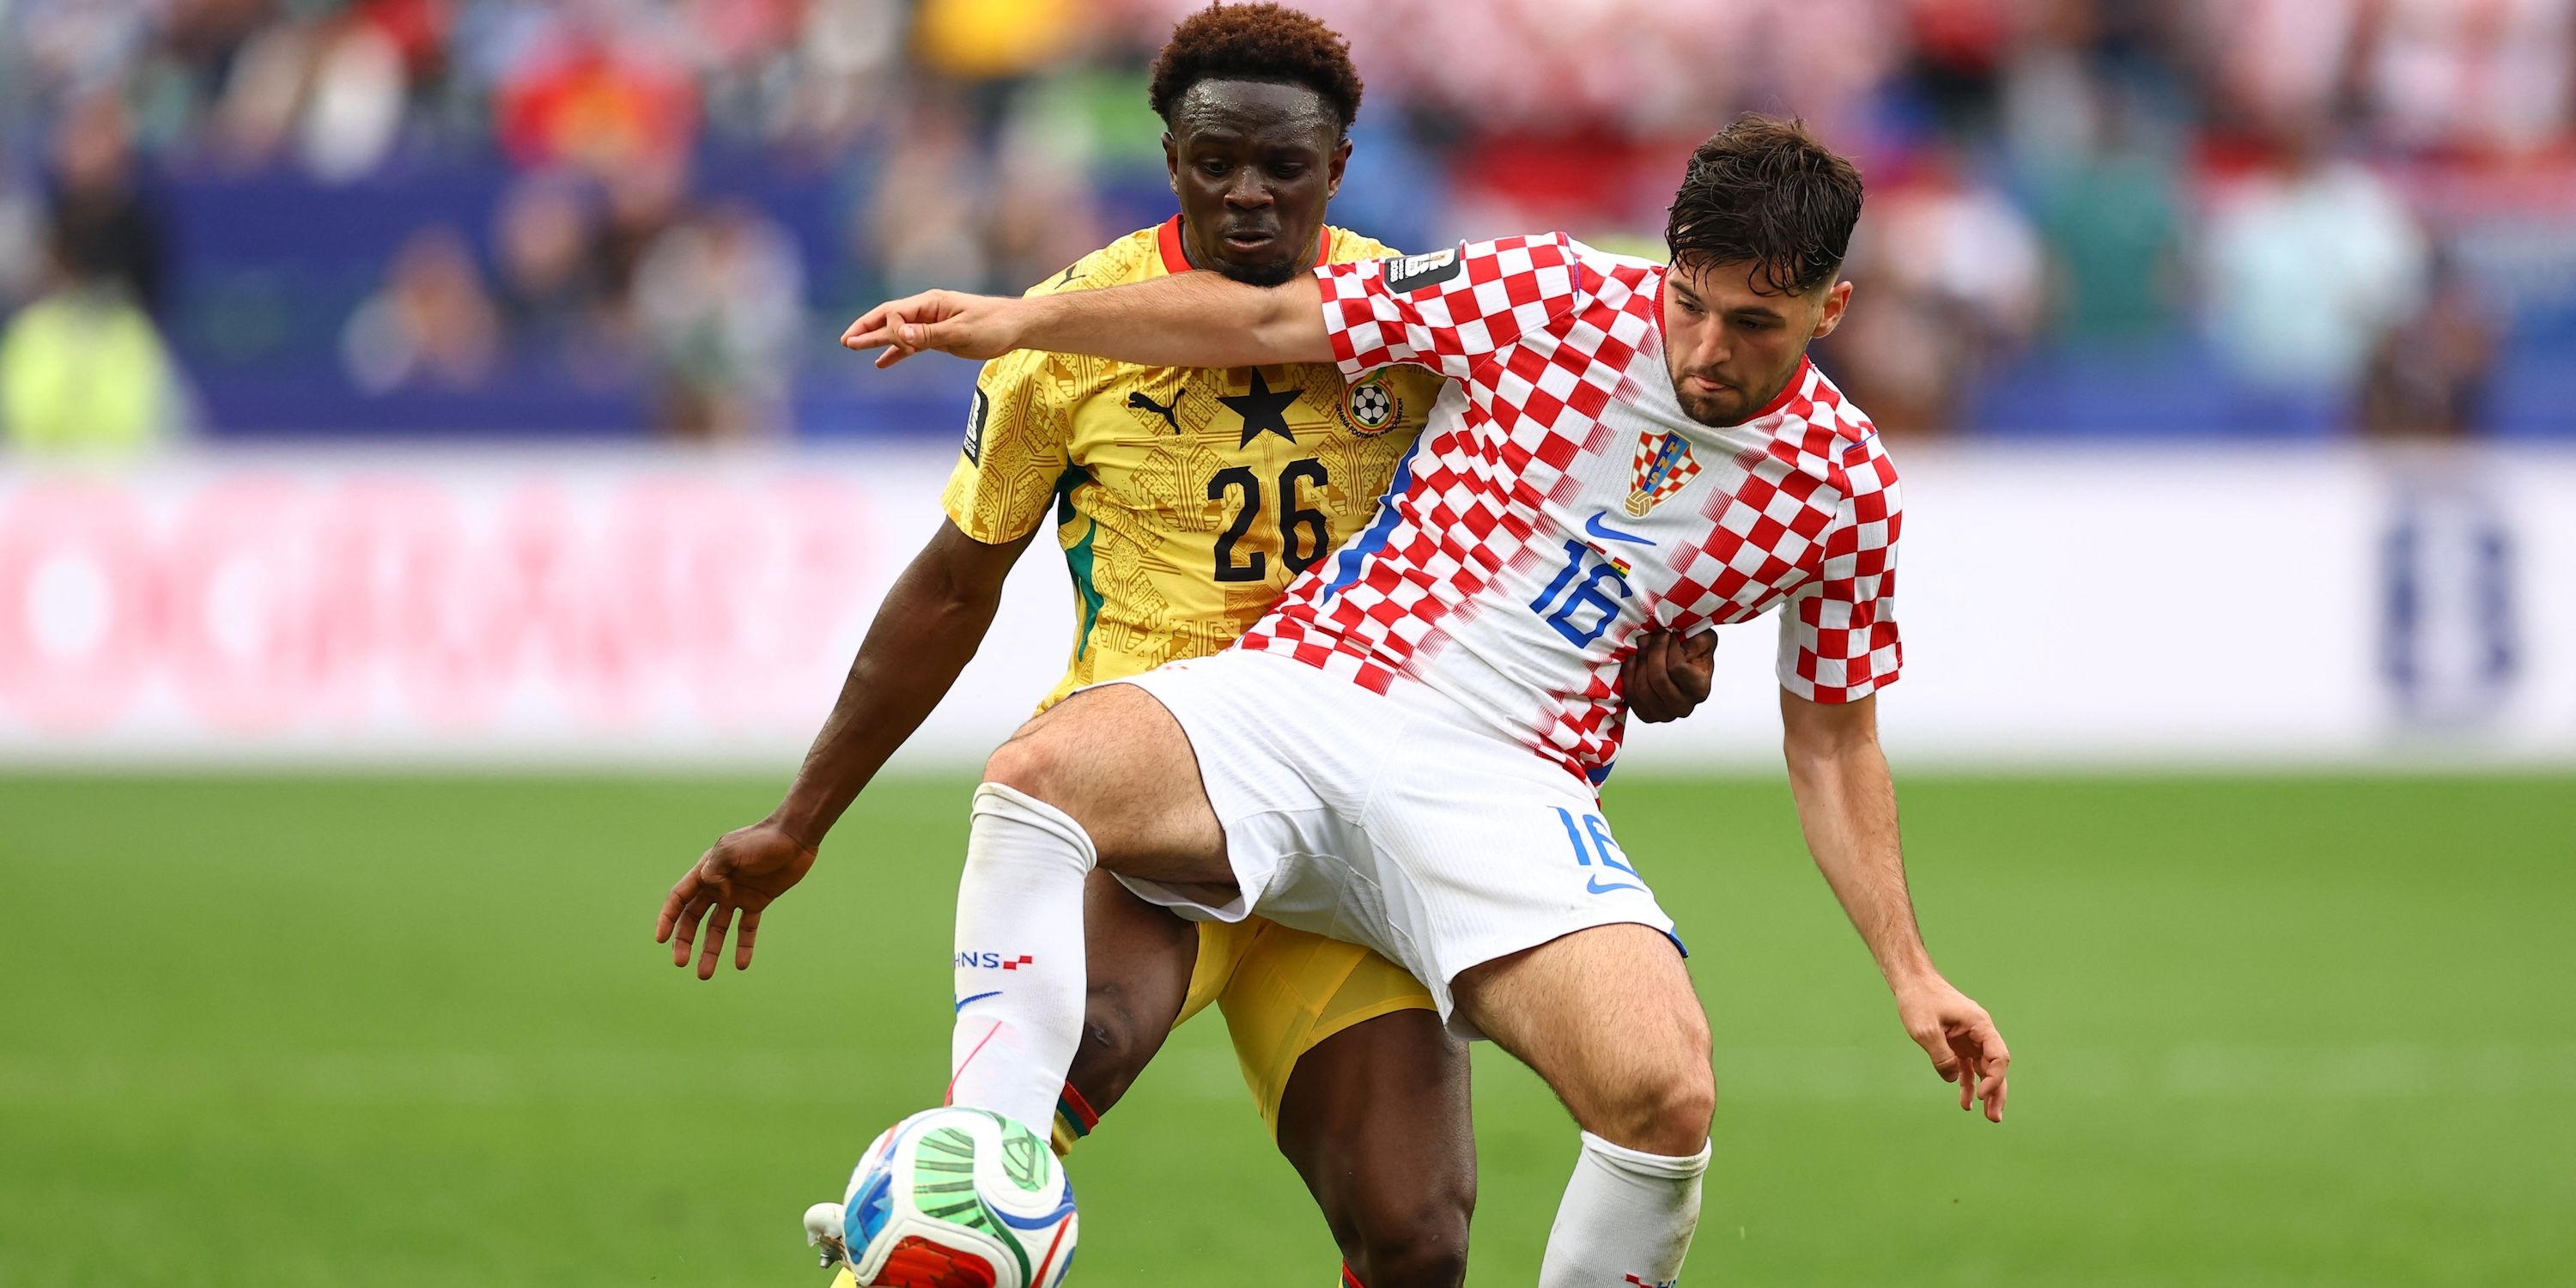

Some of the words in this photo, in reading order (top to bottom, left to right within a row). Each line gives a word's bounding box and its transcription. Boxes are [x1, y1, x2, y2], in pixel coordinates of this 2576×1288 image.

[1649, 441, 1680, 484] HNS
[1207, 458, 1329, 581] 26
[1529, 539, 1632, 649] 16
